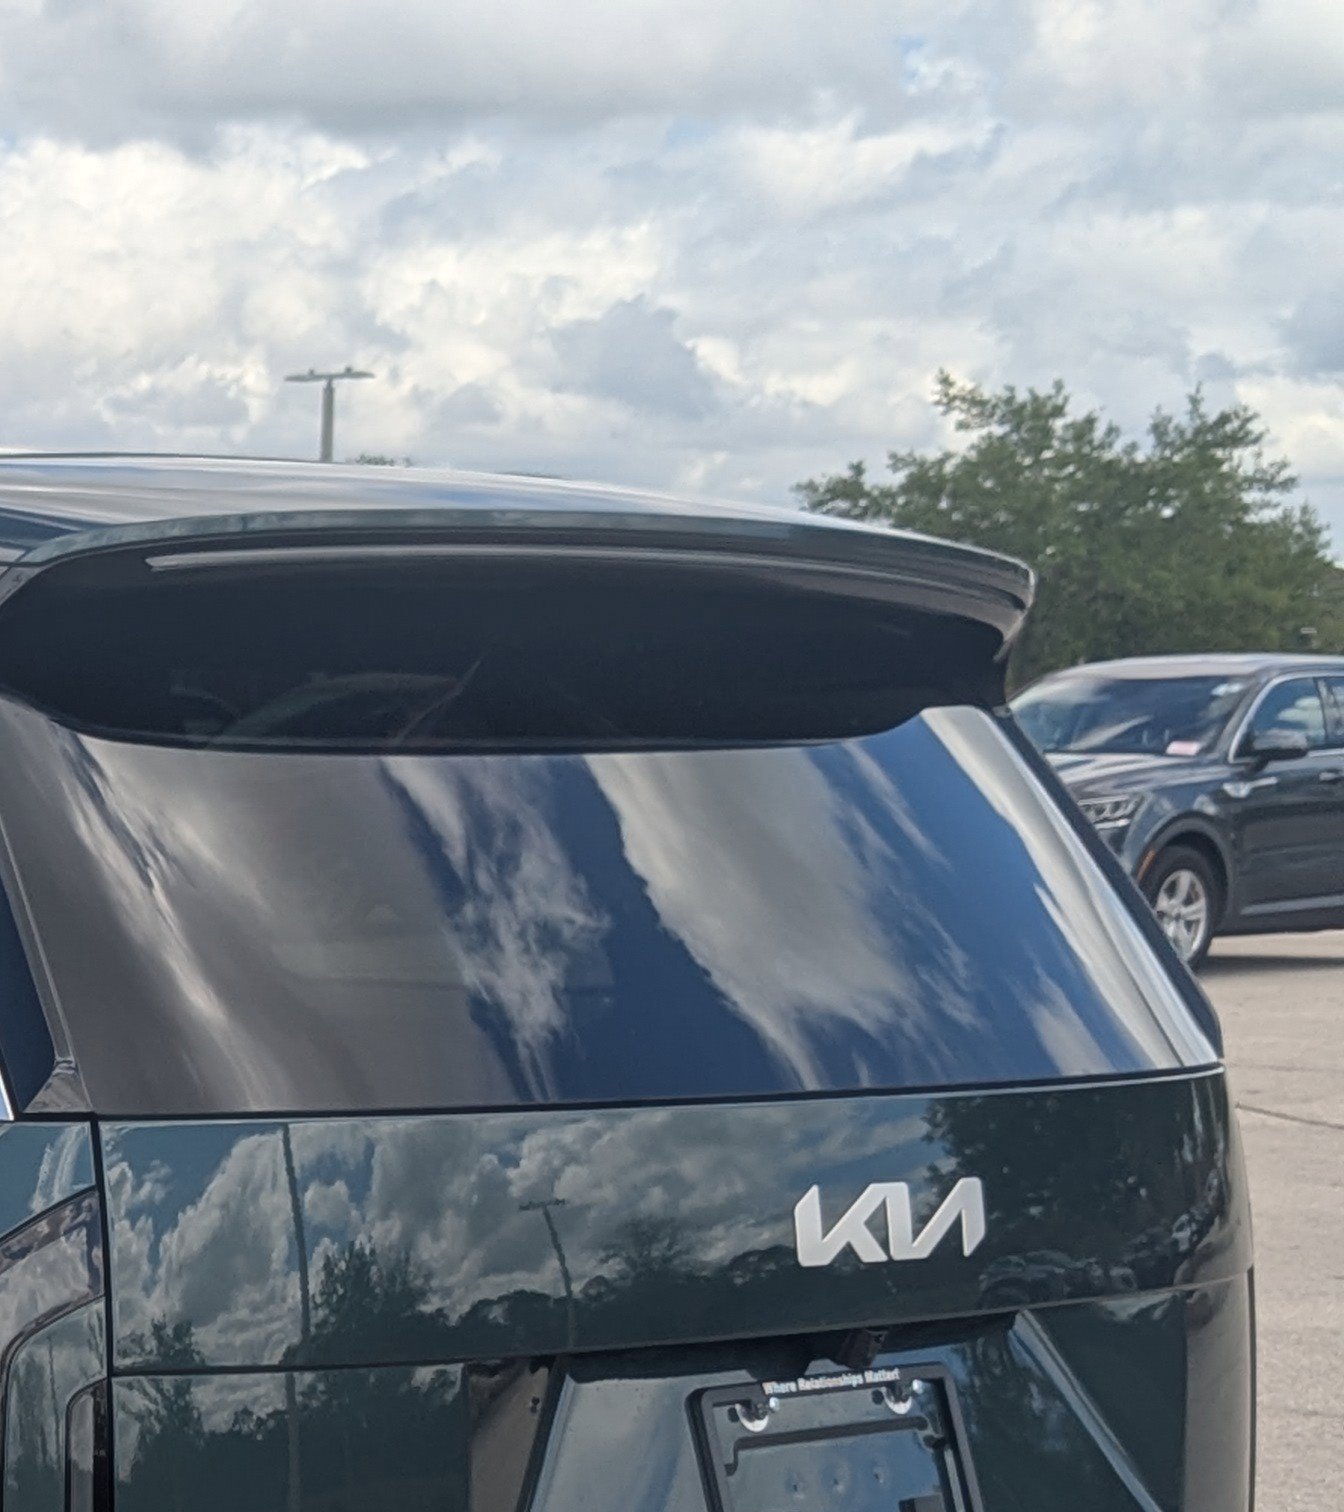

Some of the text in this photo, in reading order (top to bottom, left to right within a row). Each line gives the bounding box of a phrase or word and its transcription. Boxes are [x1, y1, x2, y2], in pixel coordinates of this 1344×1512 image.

[794, 1176, 986, 1267] KIA
[762, 1380, 797, 1395] Where
[797, 1373, 864, 1391] Relationships
